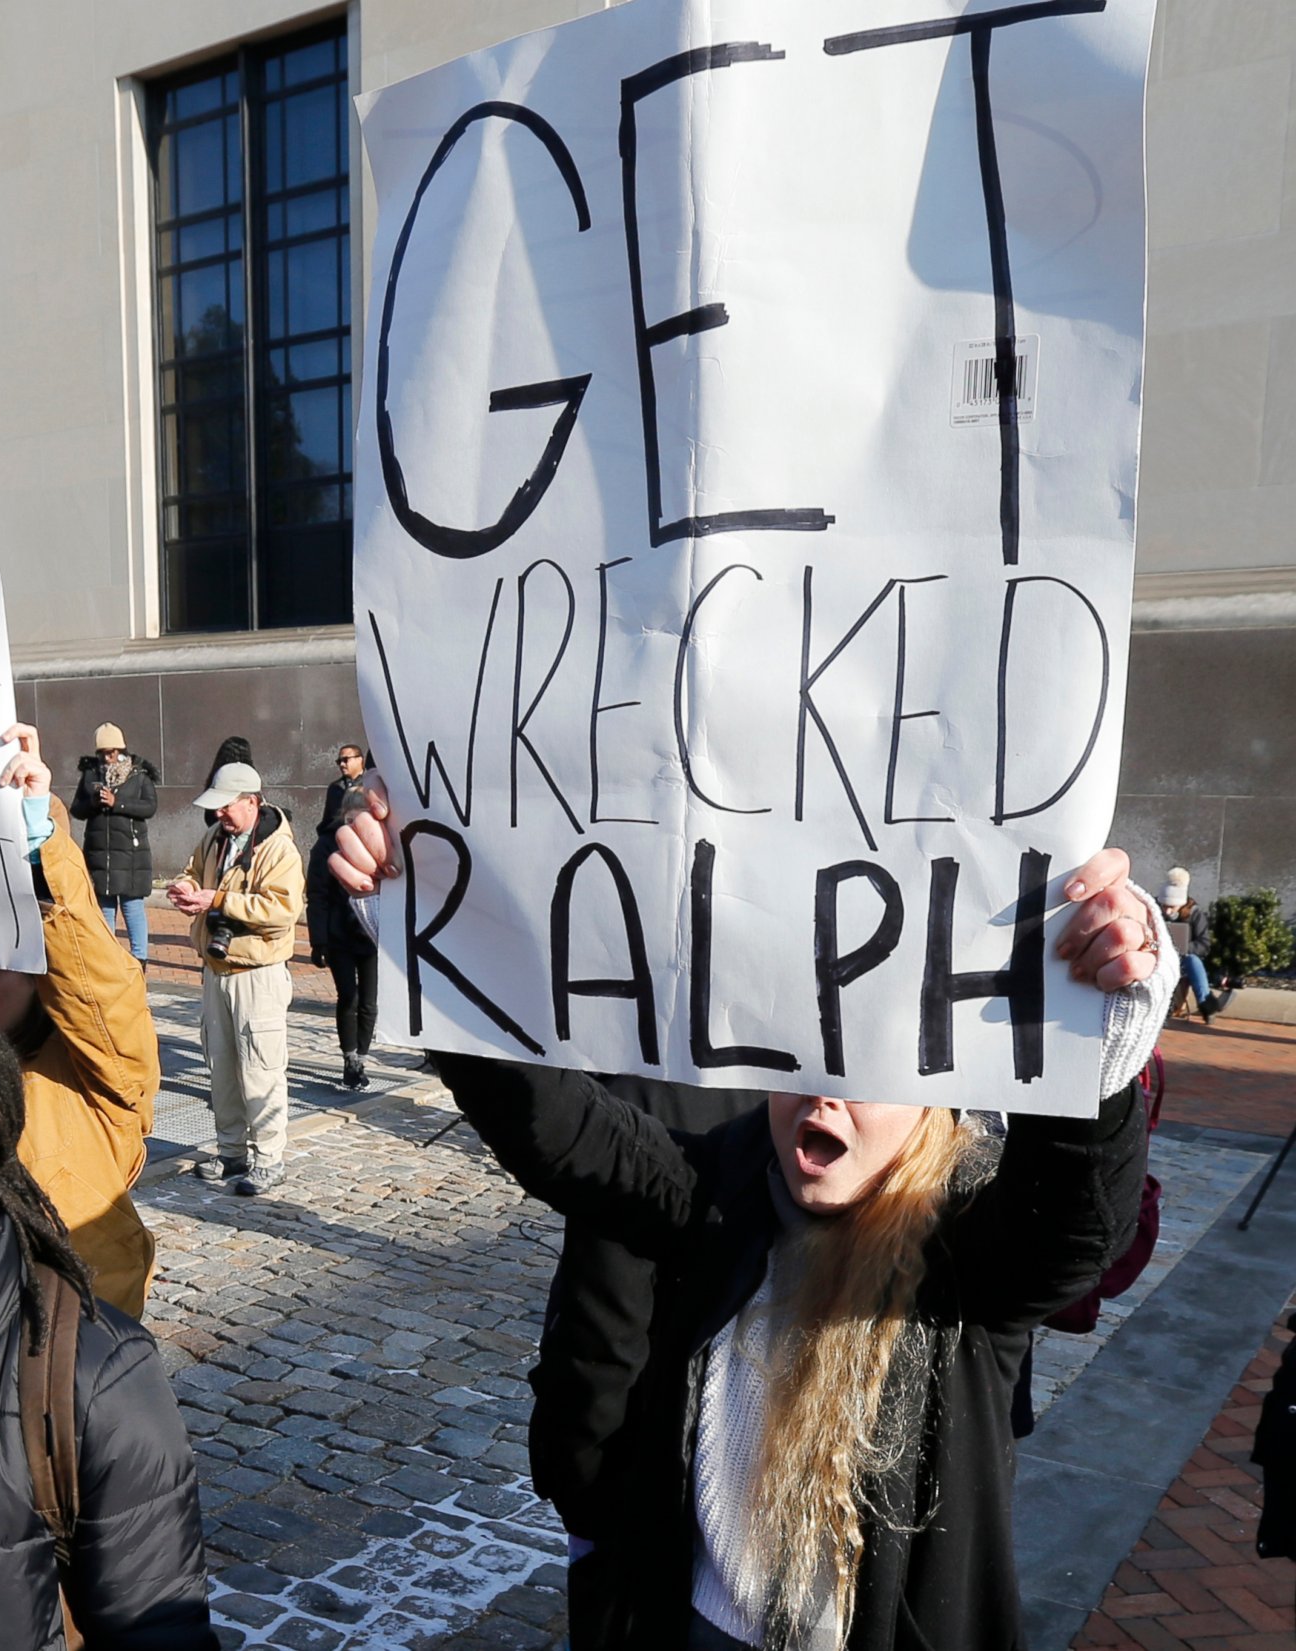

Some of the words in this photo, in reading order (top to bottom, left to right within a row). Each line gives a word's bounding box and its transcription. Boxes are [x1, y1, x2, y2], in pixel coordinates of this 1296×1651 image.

[376, 0, 1104, 566] GET
[368, 556, 1110, 851] WRECKED
[401, 819, 1052, 1083] RALPH
